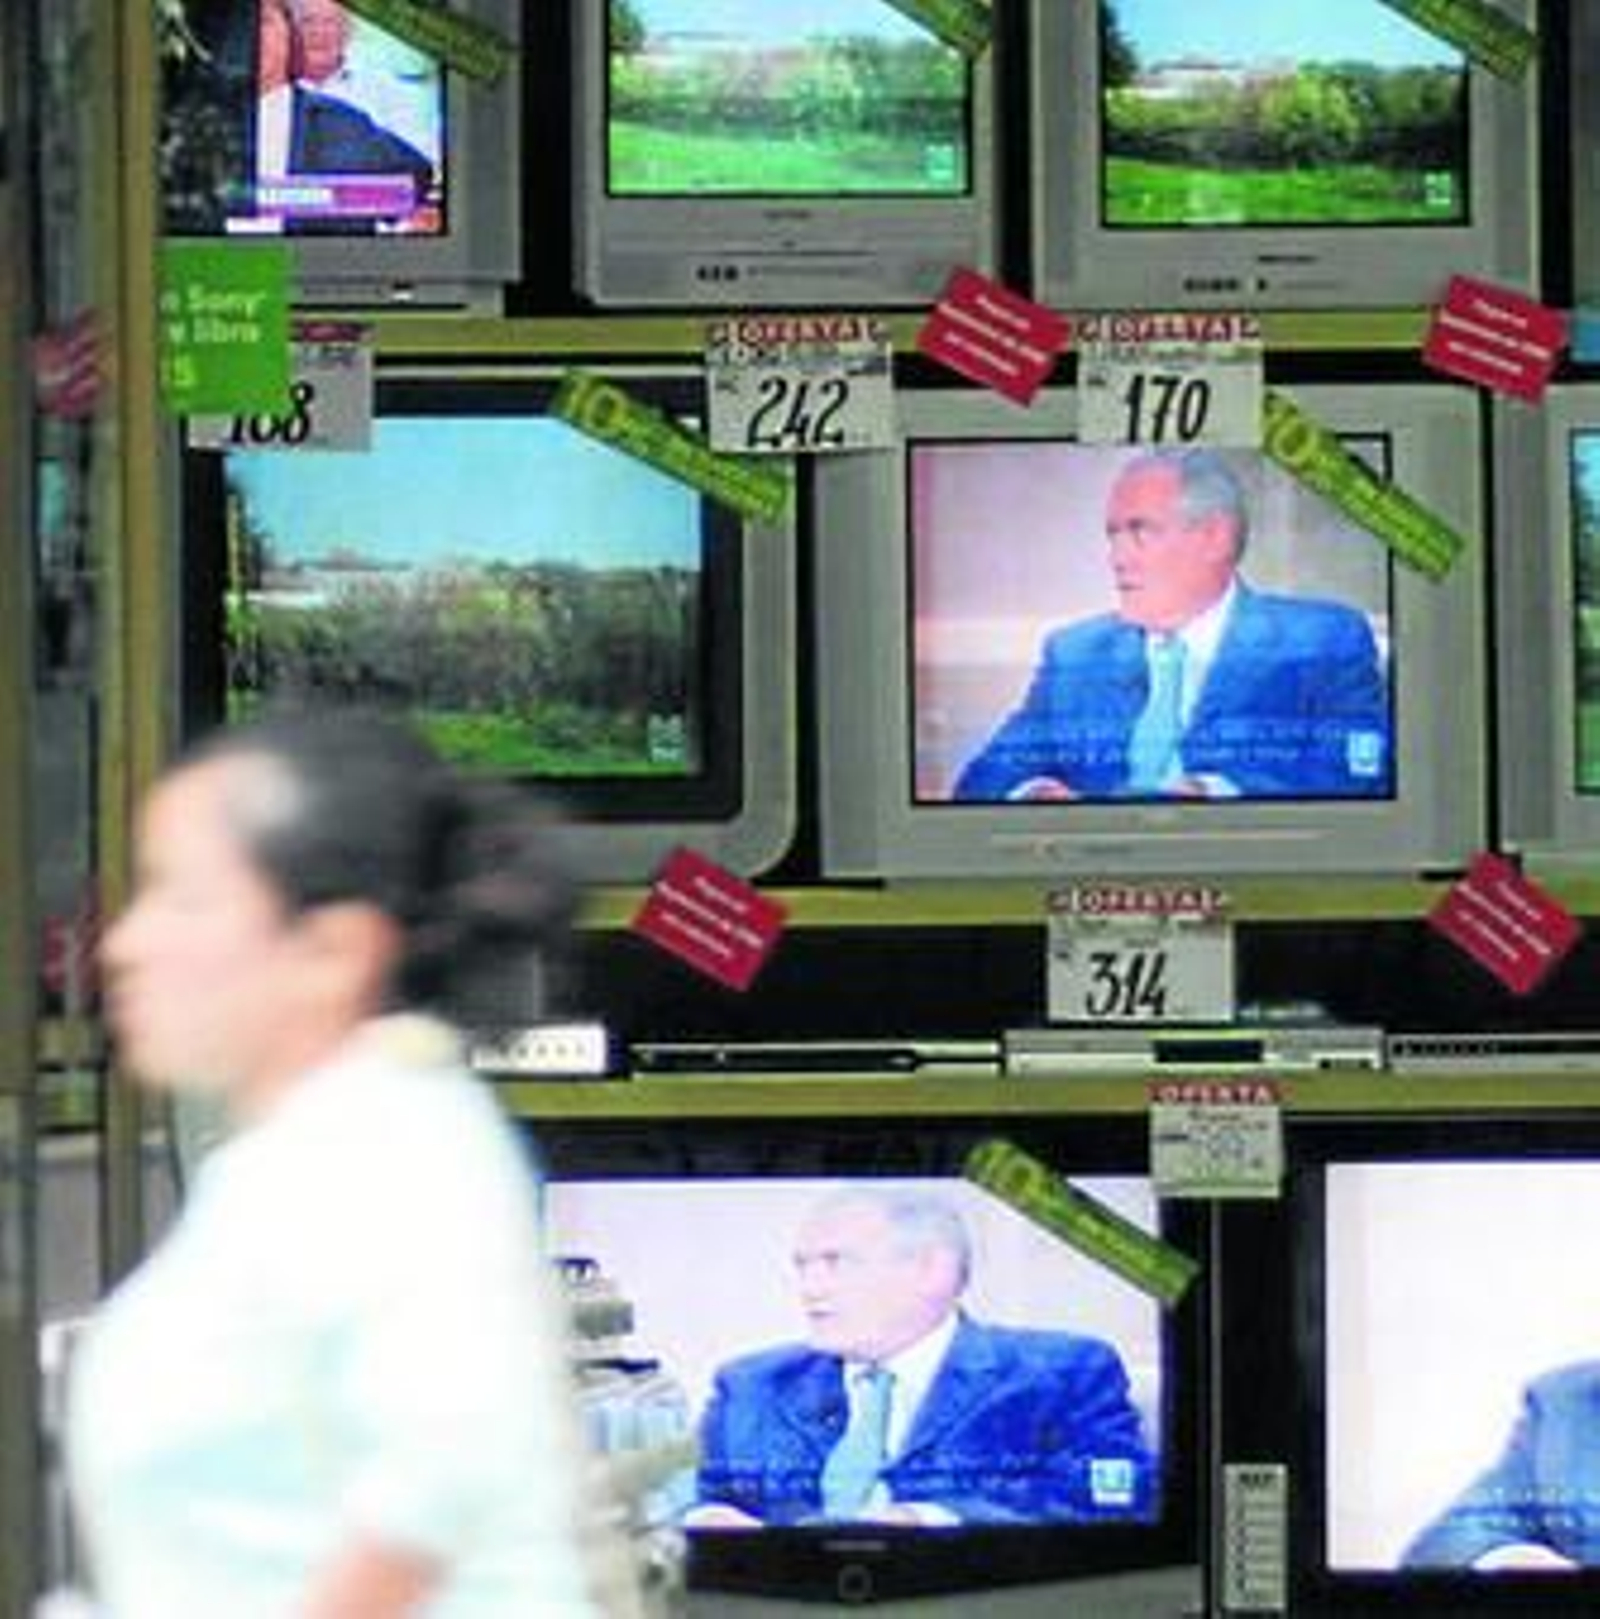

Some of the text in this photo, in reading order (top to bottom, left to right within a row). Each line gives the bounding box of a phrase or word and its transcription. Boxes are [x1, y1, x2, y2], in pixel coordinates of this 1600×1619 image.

[741, 317, 856, 344] OFERTA
[1113, 315, 1228, 343] OFERTA
[748, 374, 849, 447] 242
[1126, 374, 1211, 443] 170
[1085, 952, 1167, 1016] 314
[1159, 1082, 1272, 1107] OFERTA
